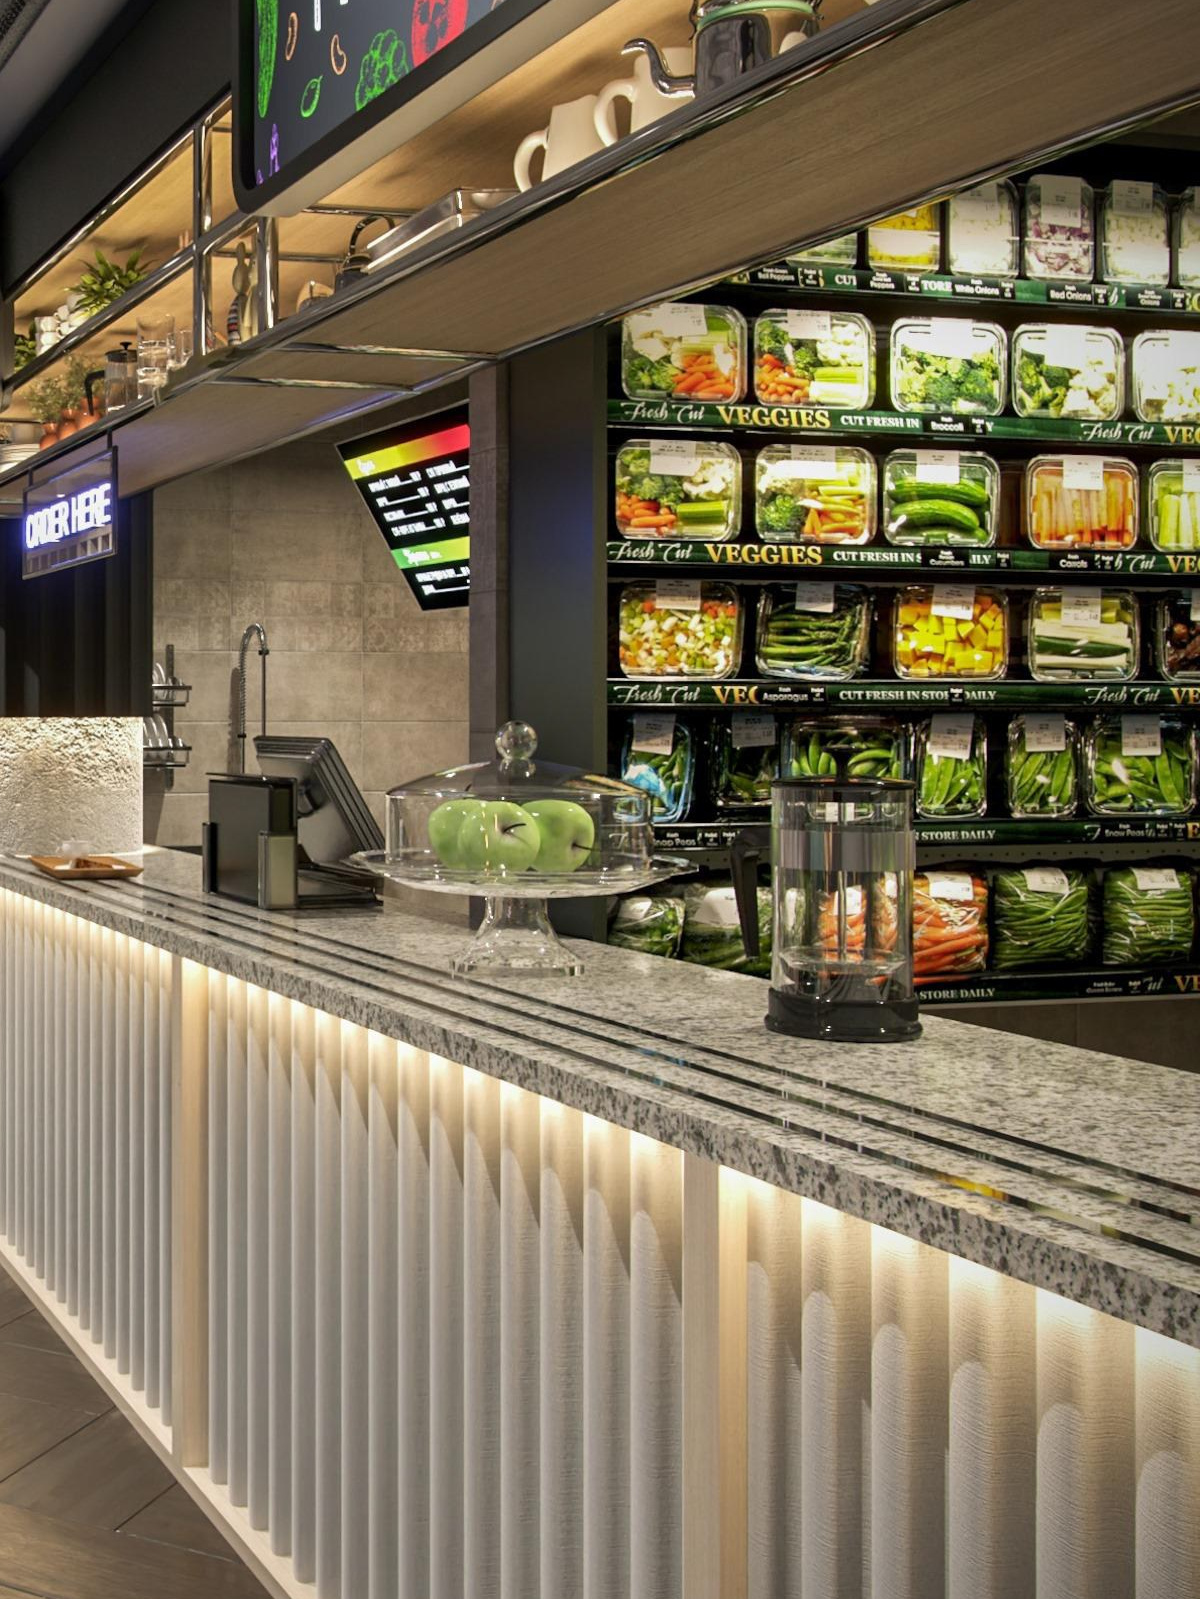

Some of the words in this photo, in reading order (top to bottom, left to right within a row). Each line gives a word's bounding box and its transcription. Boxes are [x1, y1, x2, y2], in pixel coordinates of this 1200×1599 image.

[921, 279, 953, 293] TORE
[1065, 290, 1092, 302] Onions
[620, 401, 668, 421] Fresh
[672, 404, 704, 424] Cut
[716, 405, 831, 429] VEGGIES
[840, 414, 864, 426] CUT
[864, 416, 904, 428] FRESH
[906, 417, 920, 429] IN
[931, 420, 964, 432] Broccoli
[1079, 422, 1122, 441] Fresh
[1125, 424, 1154, 443] Cut
[26, 501, 70, 548] ORDER
[71, 483, 111, 533] HERE
[606, 541, 654, 561] Fresh
[658, 543, 693, 564] Cut
[704, 543, 823, 566] VEGGIES
[833, 551, 858, 561] CUT
[858, 551, 899, 562] FRESH
[900, 552, 914, 563] IN
[1125, 554, 1157, 573] Cut
[613, 684, 662, 704] Fresh
[666, 687, 700, 704] Cut
[763, 692, 809, 702] Asparagus
[839, 690, 864, 700] CUT
[865, 690, 905, 700] FRESH
[906, 690, 920, 700] IN
[921, 690, 949, 700] STO
[1084, 685, 1128, 706] Fresh
[1130, 687, 1160, 706] Cut
[675, 838, 696, 846] Peas
[921, 831, 959, 841] STORE
[961, 830, 996, 840] DAILY
[919, 990, 957, 1000] STORE
[960, 988, 995, 998] DAILY
